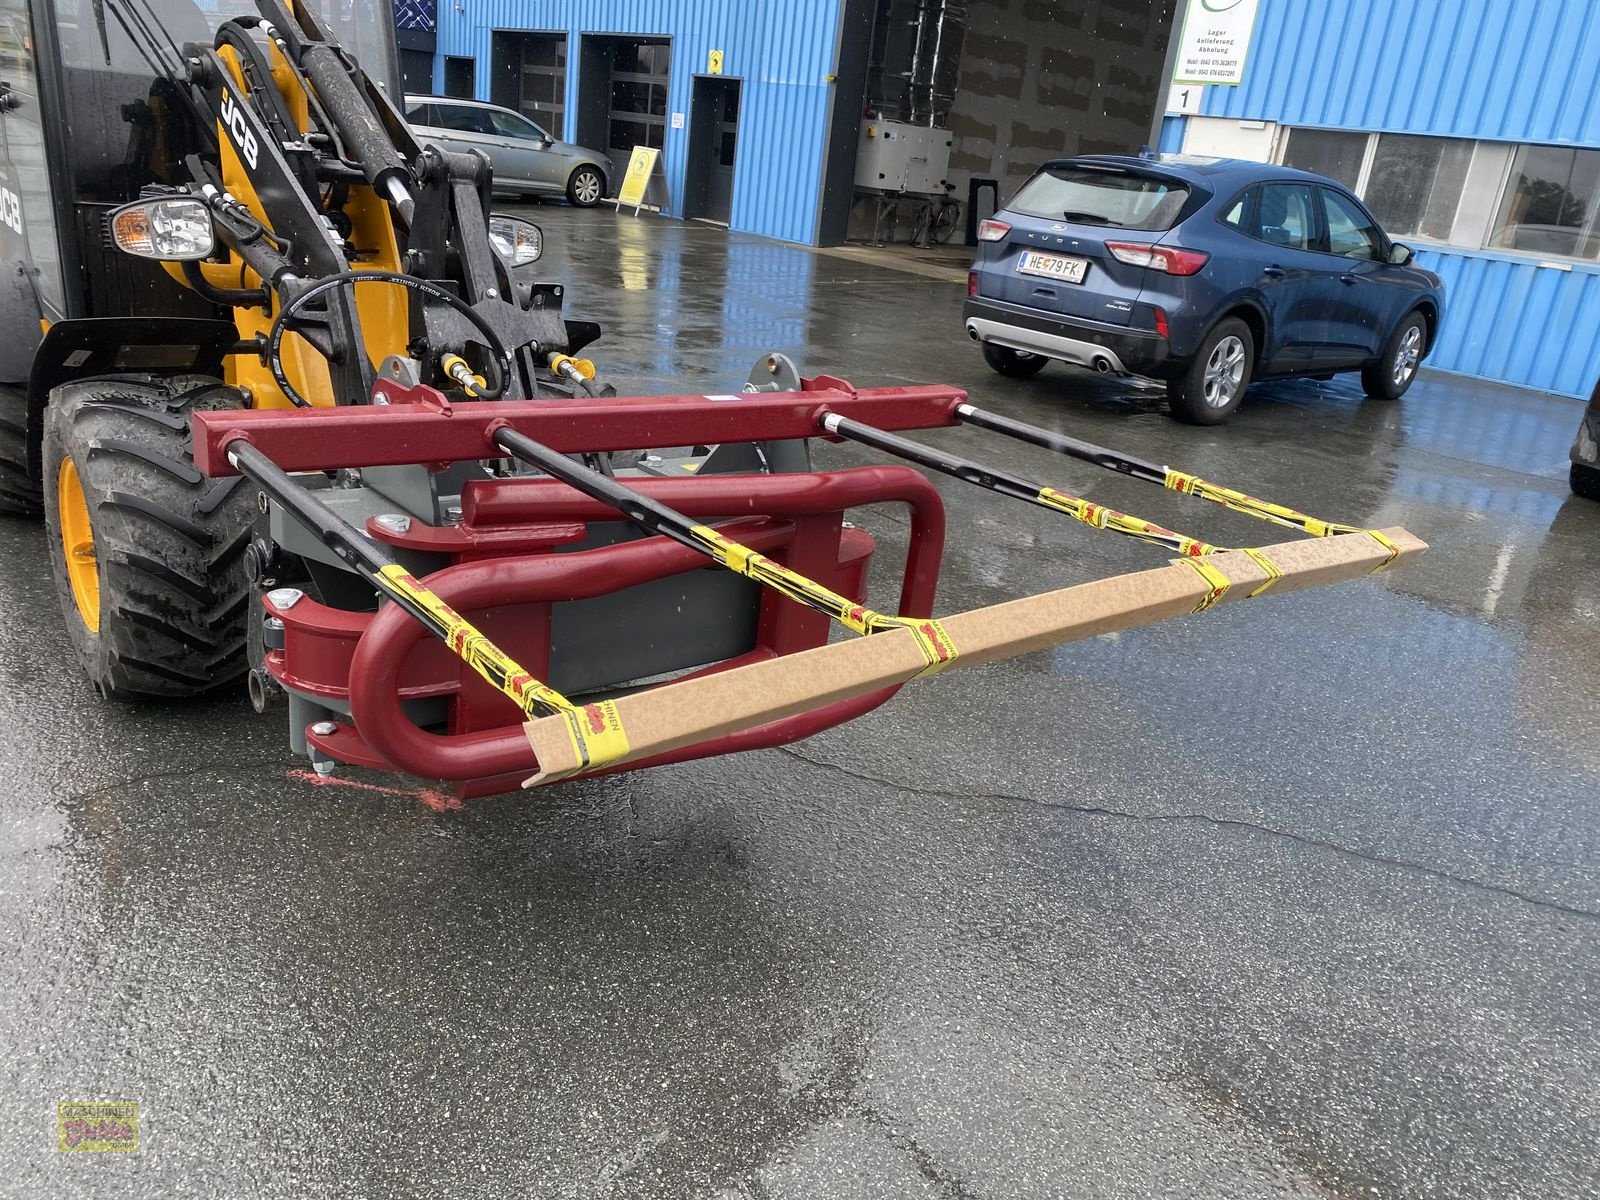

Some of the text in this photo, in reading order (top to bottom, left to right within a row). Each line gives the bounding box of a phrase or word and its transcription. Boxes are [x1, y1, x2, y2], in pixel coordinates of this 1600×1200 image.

[1198, 46, 1229, 54] Abholung
[1181, 89, 1190, 108] 1
[221, 87, 259, 170] JCB
[1030, 255, 1078, 276] HE 79 FK
